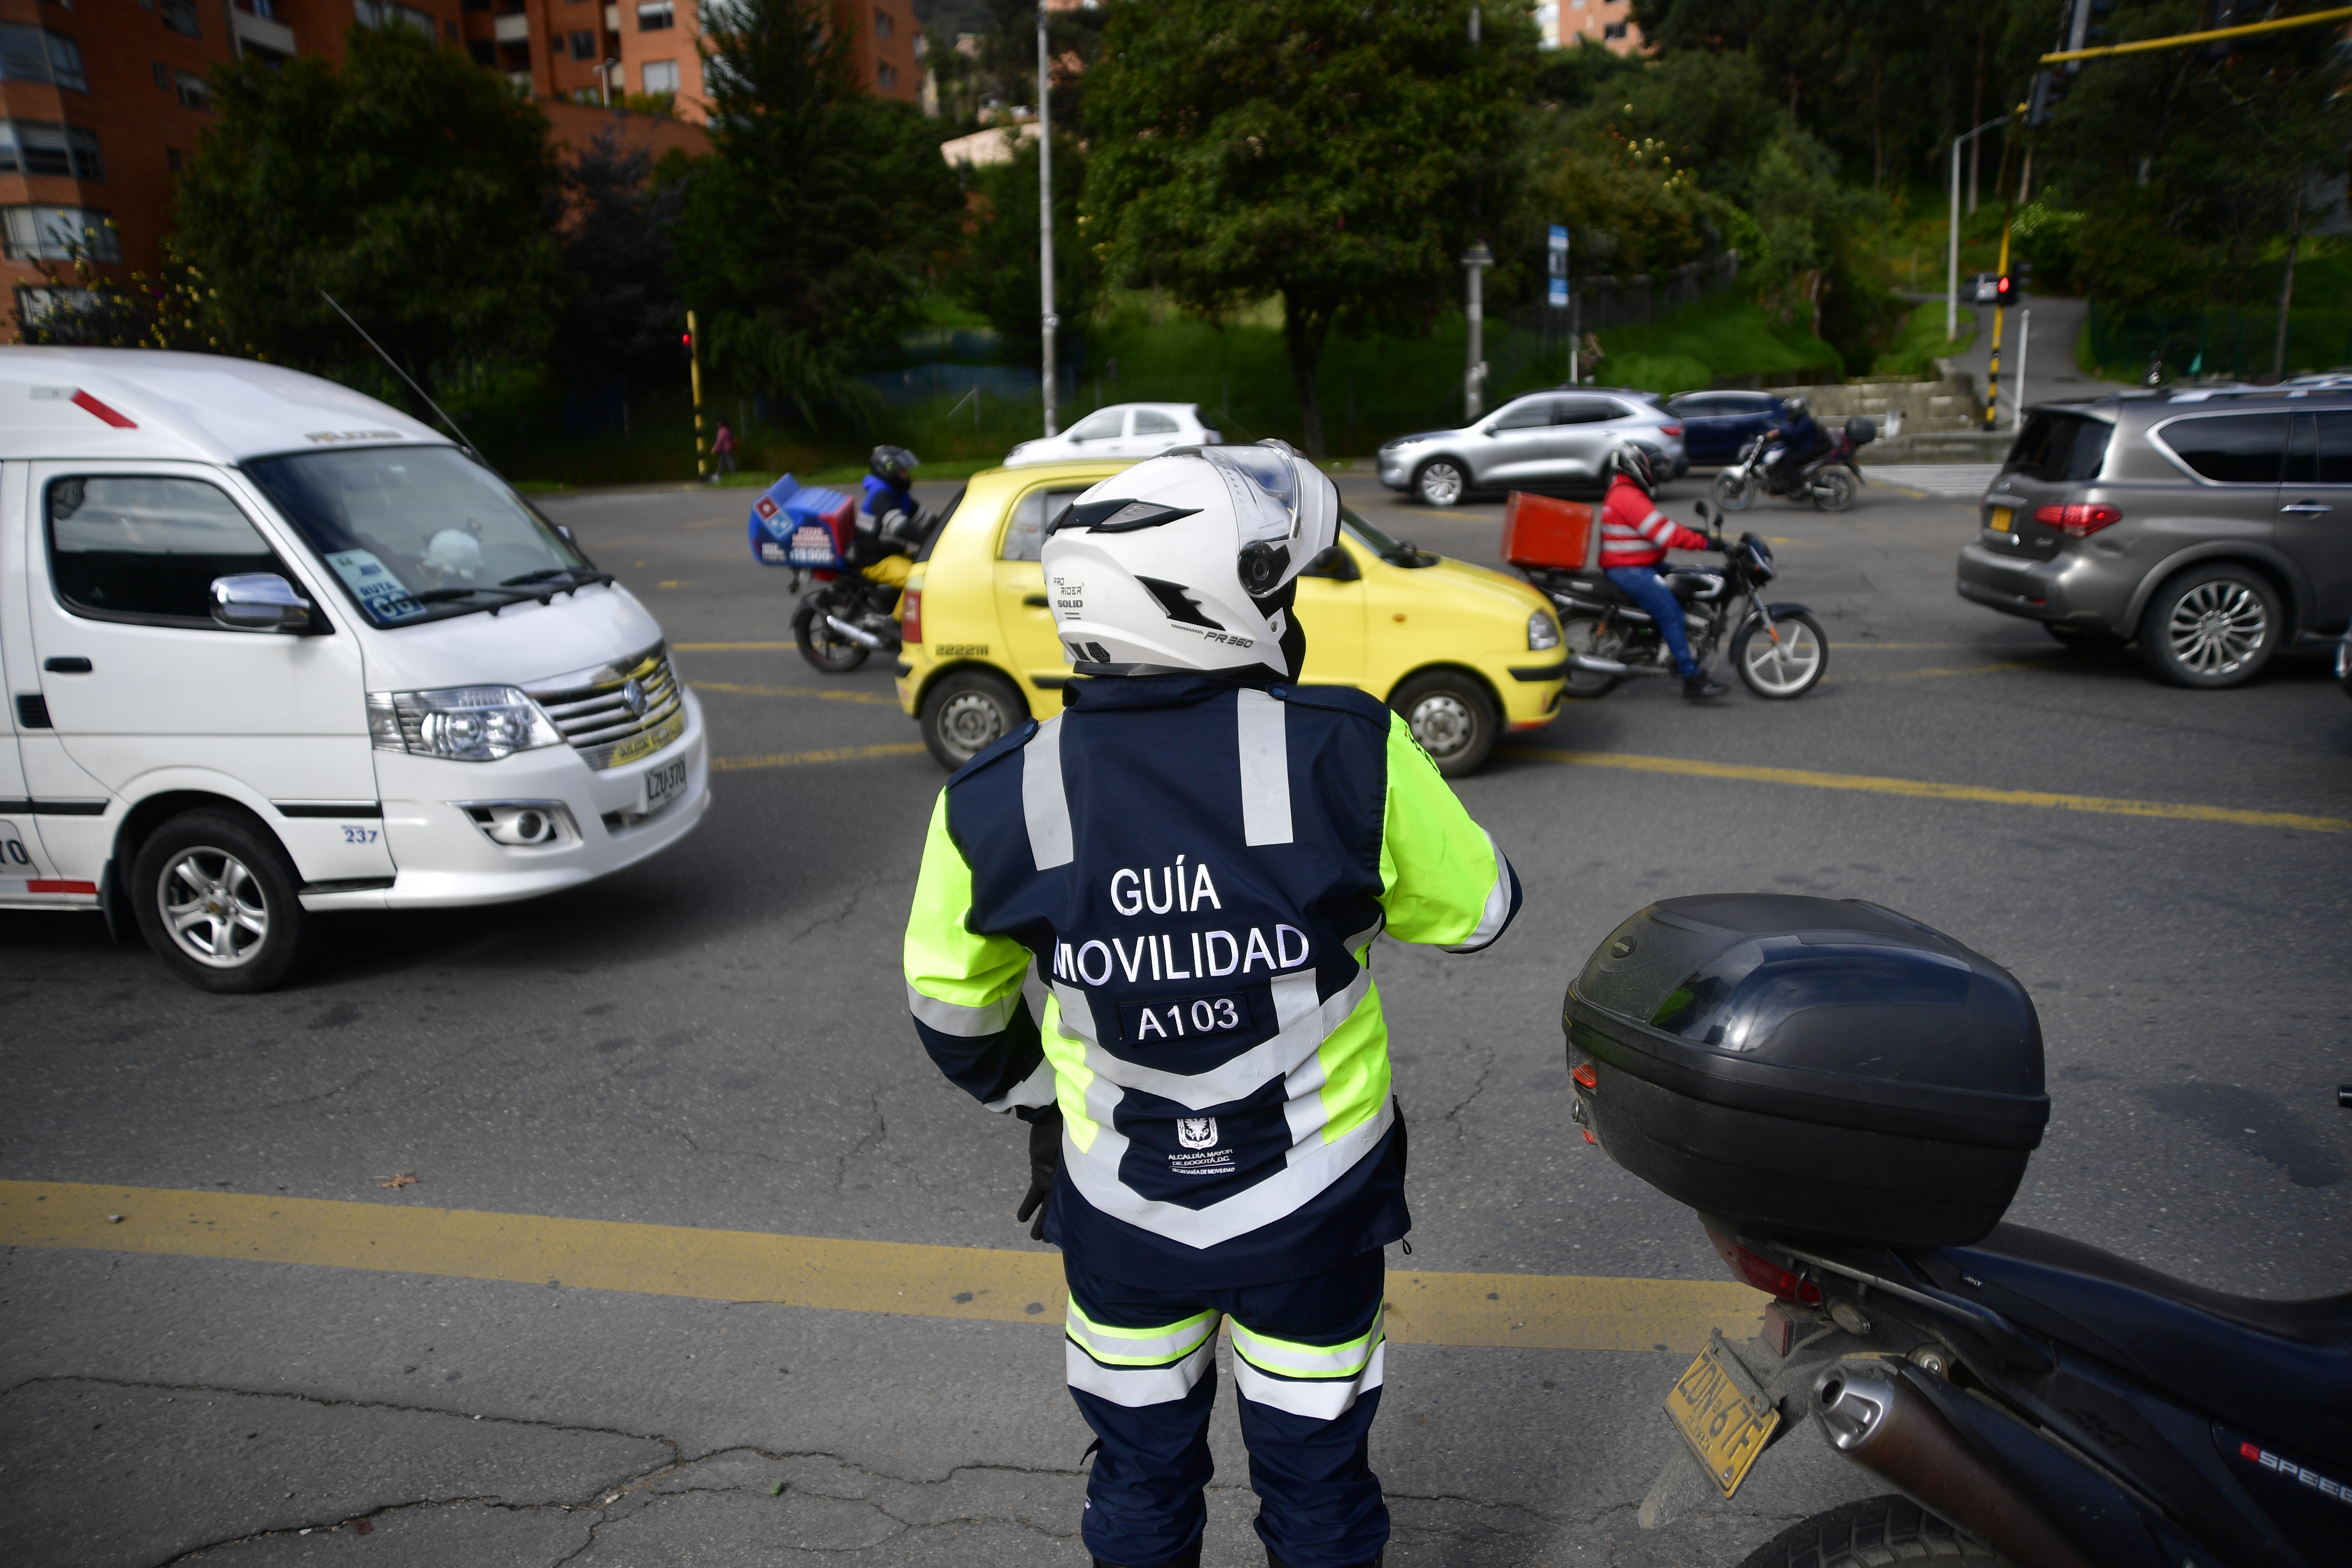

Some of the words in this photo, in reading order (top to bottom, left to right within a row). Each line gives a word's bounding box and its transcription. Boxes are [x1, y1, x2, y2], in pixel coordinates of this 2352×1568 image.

[1053, 577, 1064, 586] PRO
[359, 581, 396, 595] RUTA
[1060, 586, 1081, 595] RIDER
[1057, 599, 1083, 608] SOLID
[345, 830, 378, 842] 237
[1111, 855, 1222, 916] GUÍA
[1053, 924, 1309, 985] MOVILIDAD
[1138, 999, 1239, 1040] A103
[1168, 1152, 1206, 1160] ALCALDÍA
[1207, 1149, 1233, 1157] MAYOR
[1184, 1157, 1216, 1166] BOGOTÁ
